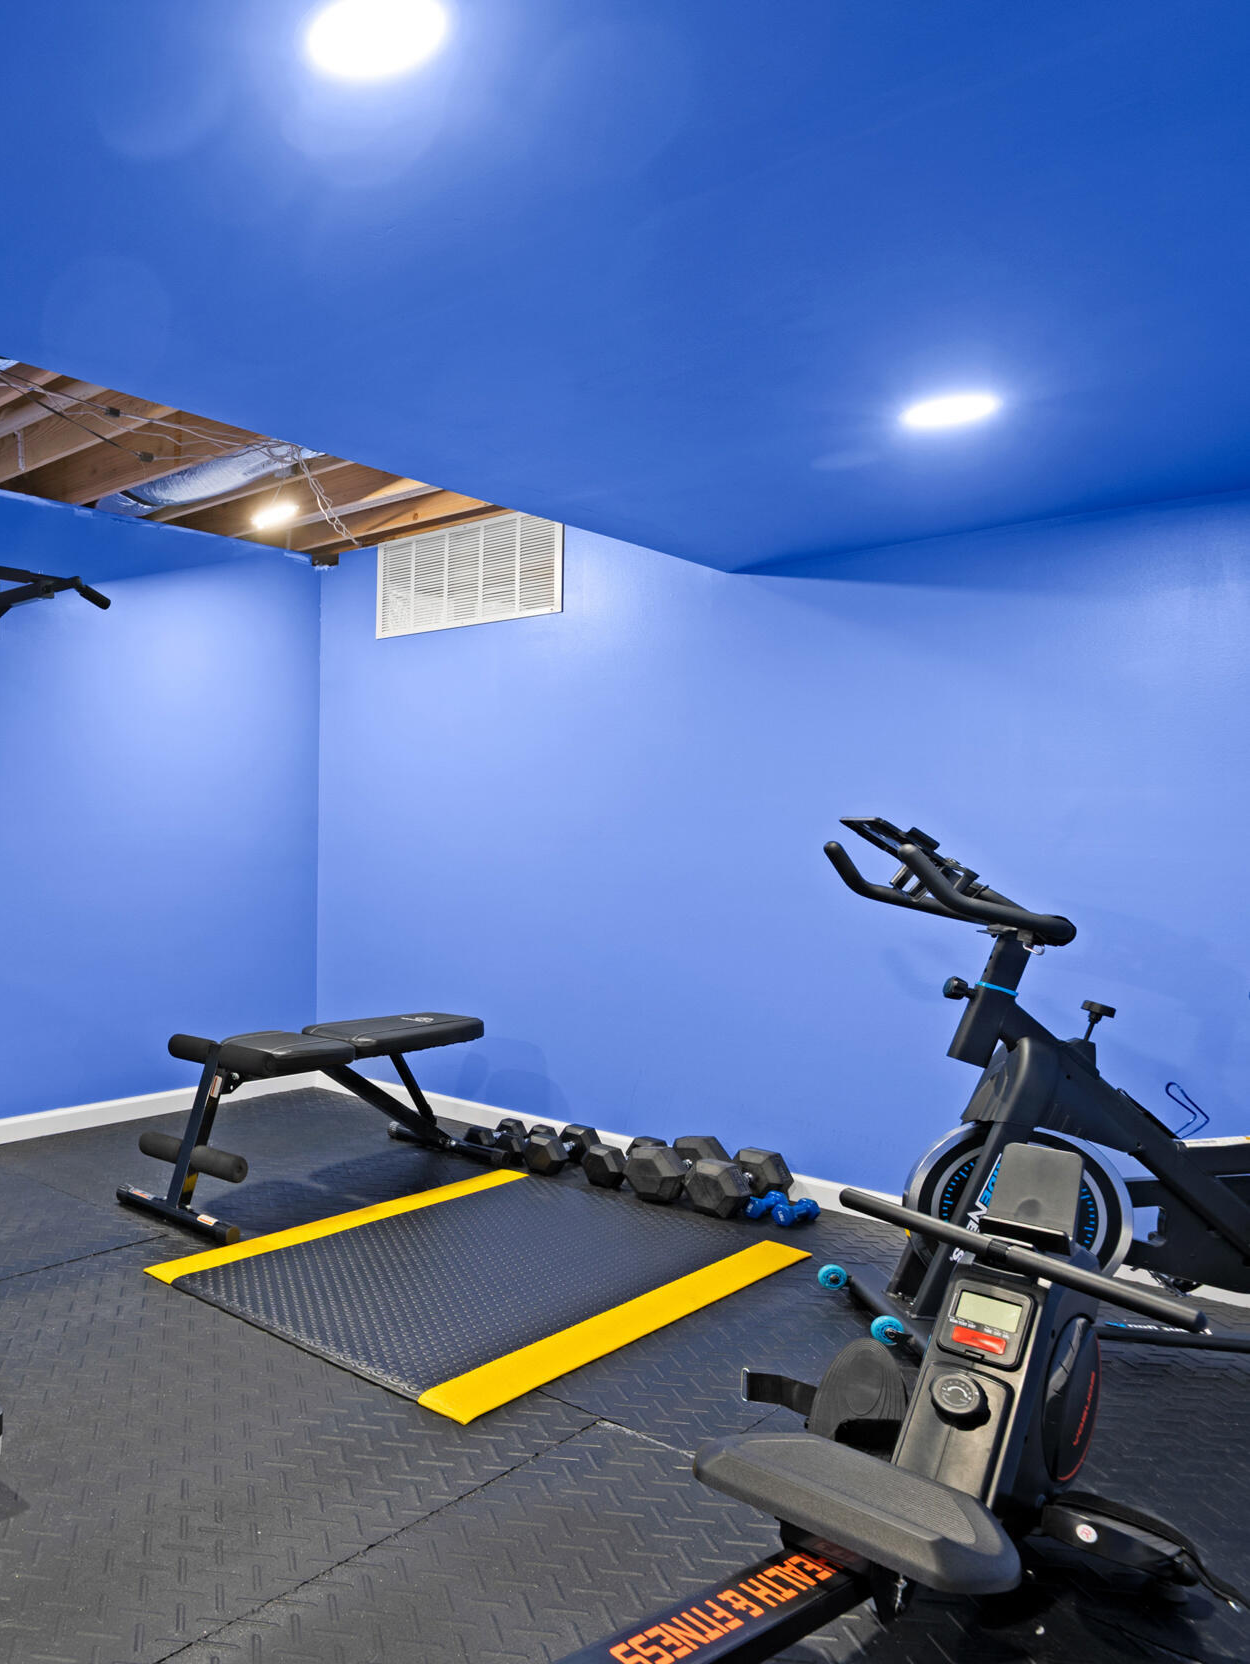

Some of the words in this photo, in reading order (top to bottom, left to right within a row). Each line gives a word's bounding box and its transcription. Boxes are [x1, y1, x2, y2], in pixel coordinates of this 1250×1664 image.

[716, 1589, 765, 1618] &
[739, 1553, 844, 1608] HEALTH
[609, 1600, 745, 1664] FITNESS
